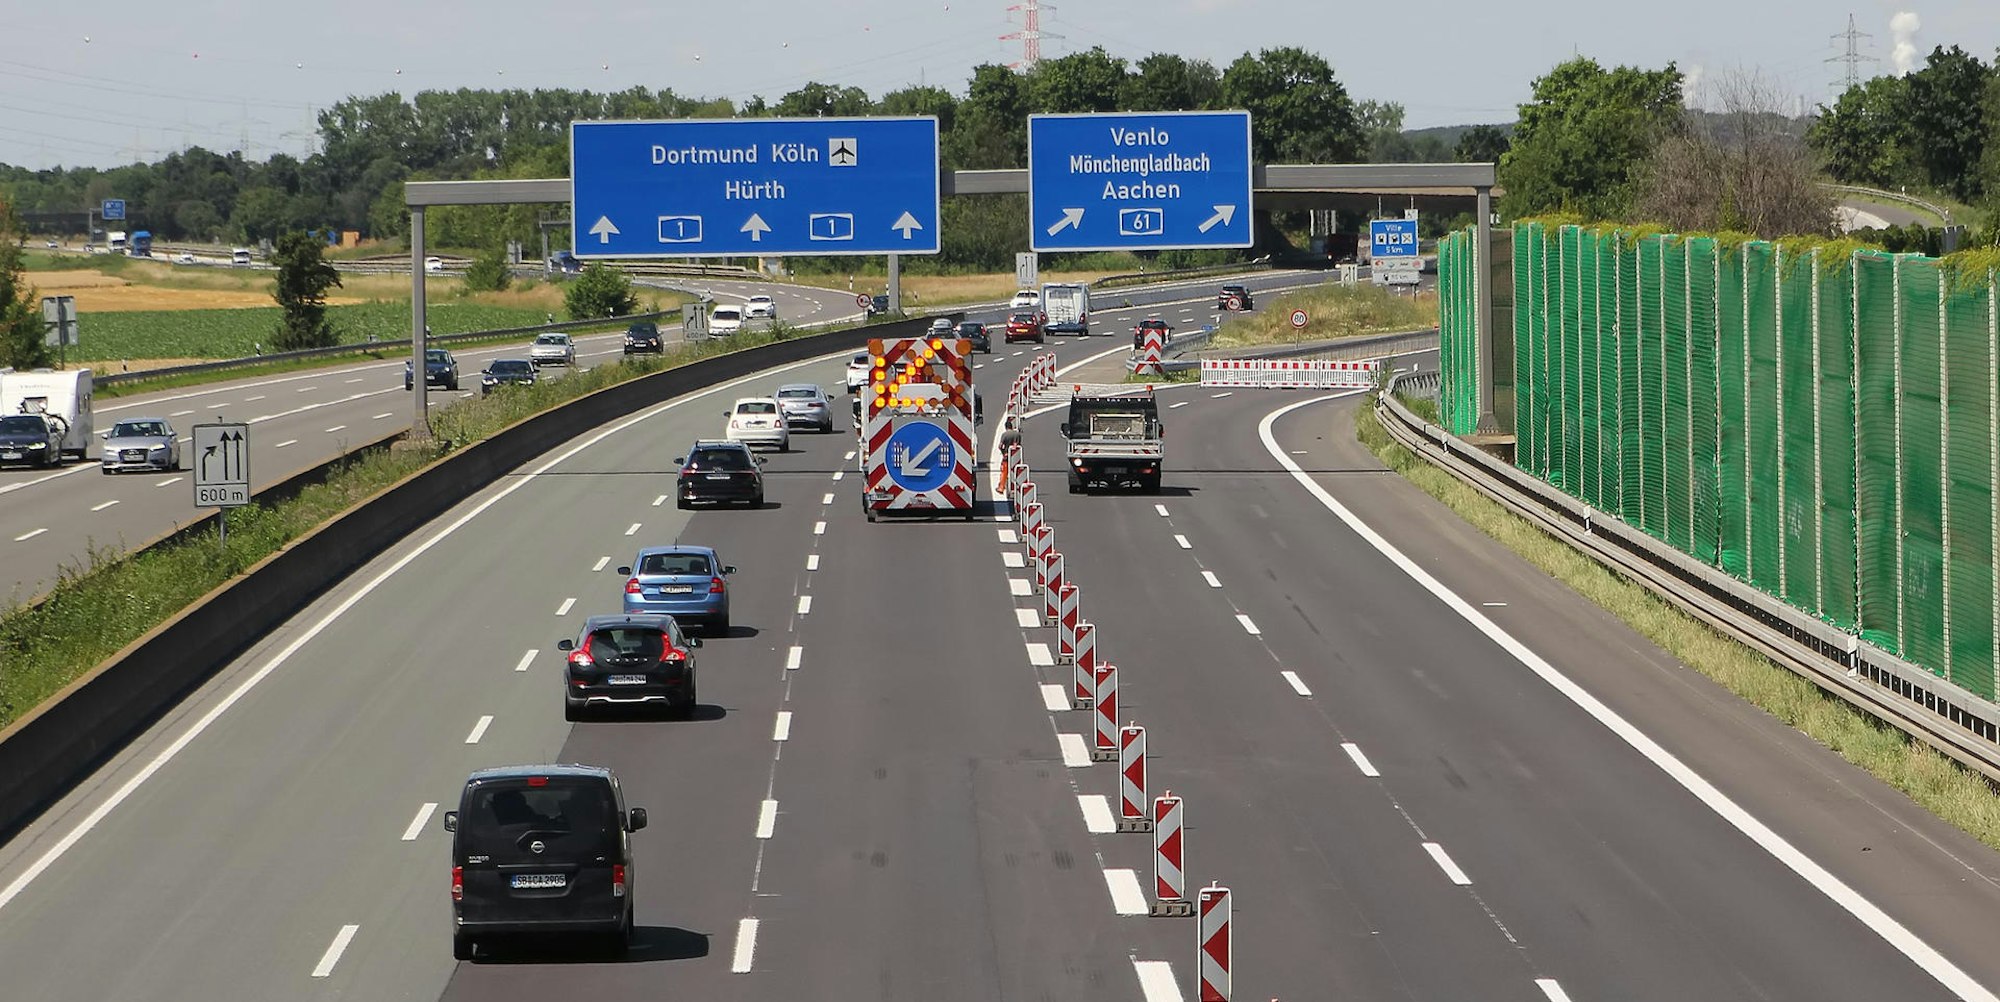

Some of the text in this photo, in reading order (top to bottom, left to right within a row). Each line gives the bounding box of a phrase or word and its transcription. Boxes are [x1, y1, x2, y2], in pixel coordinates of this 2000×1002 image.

[1110, 127, 1169, 146] Venlo
[652, 143, 819, 164] Dortmund Köln
[1070, 152, 1210, 177] Mönchengladbach
[725, 180, 785, 200] Hürth
[1102, 180, 1180, 200] Aachen
[677, 221, 684, 237] 1
[828, 218, 835, 236] 1
[1133, 213, 1150, 230] 61
[1391, 246, 1403, 254] km
[1294, 314, 1305, 323] 80
[201, 488, 243, 501] 600 m
